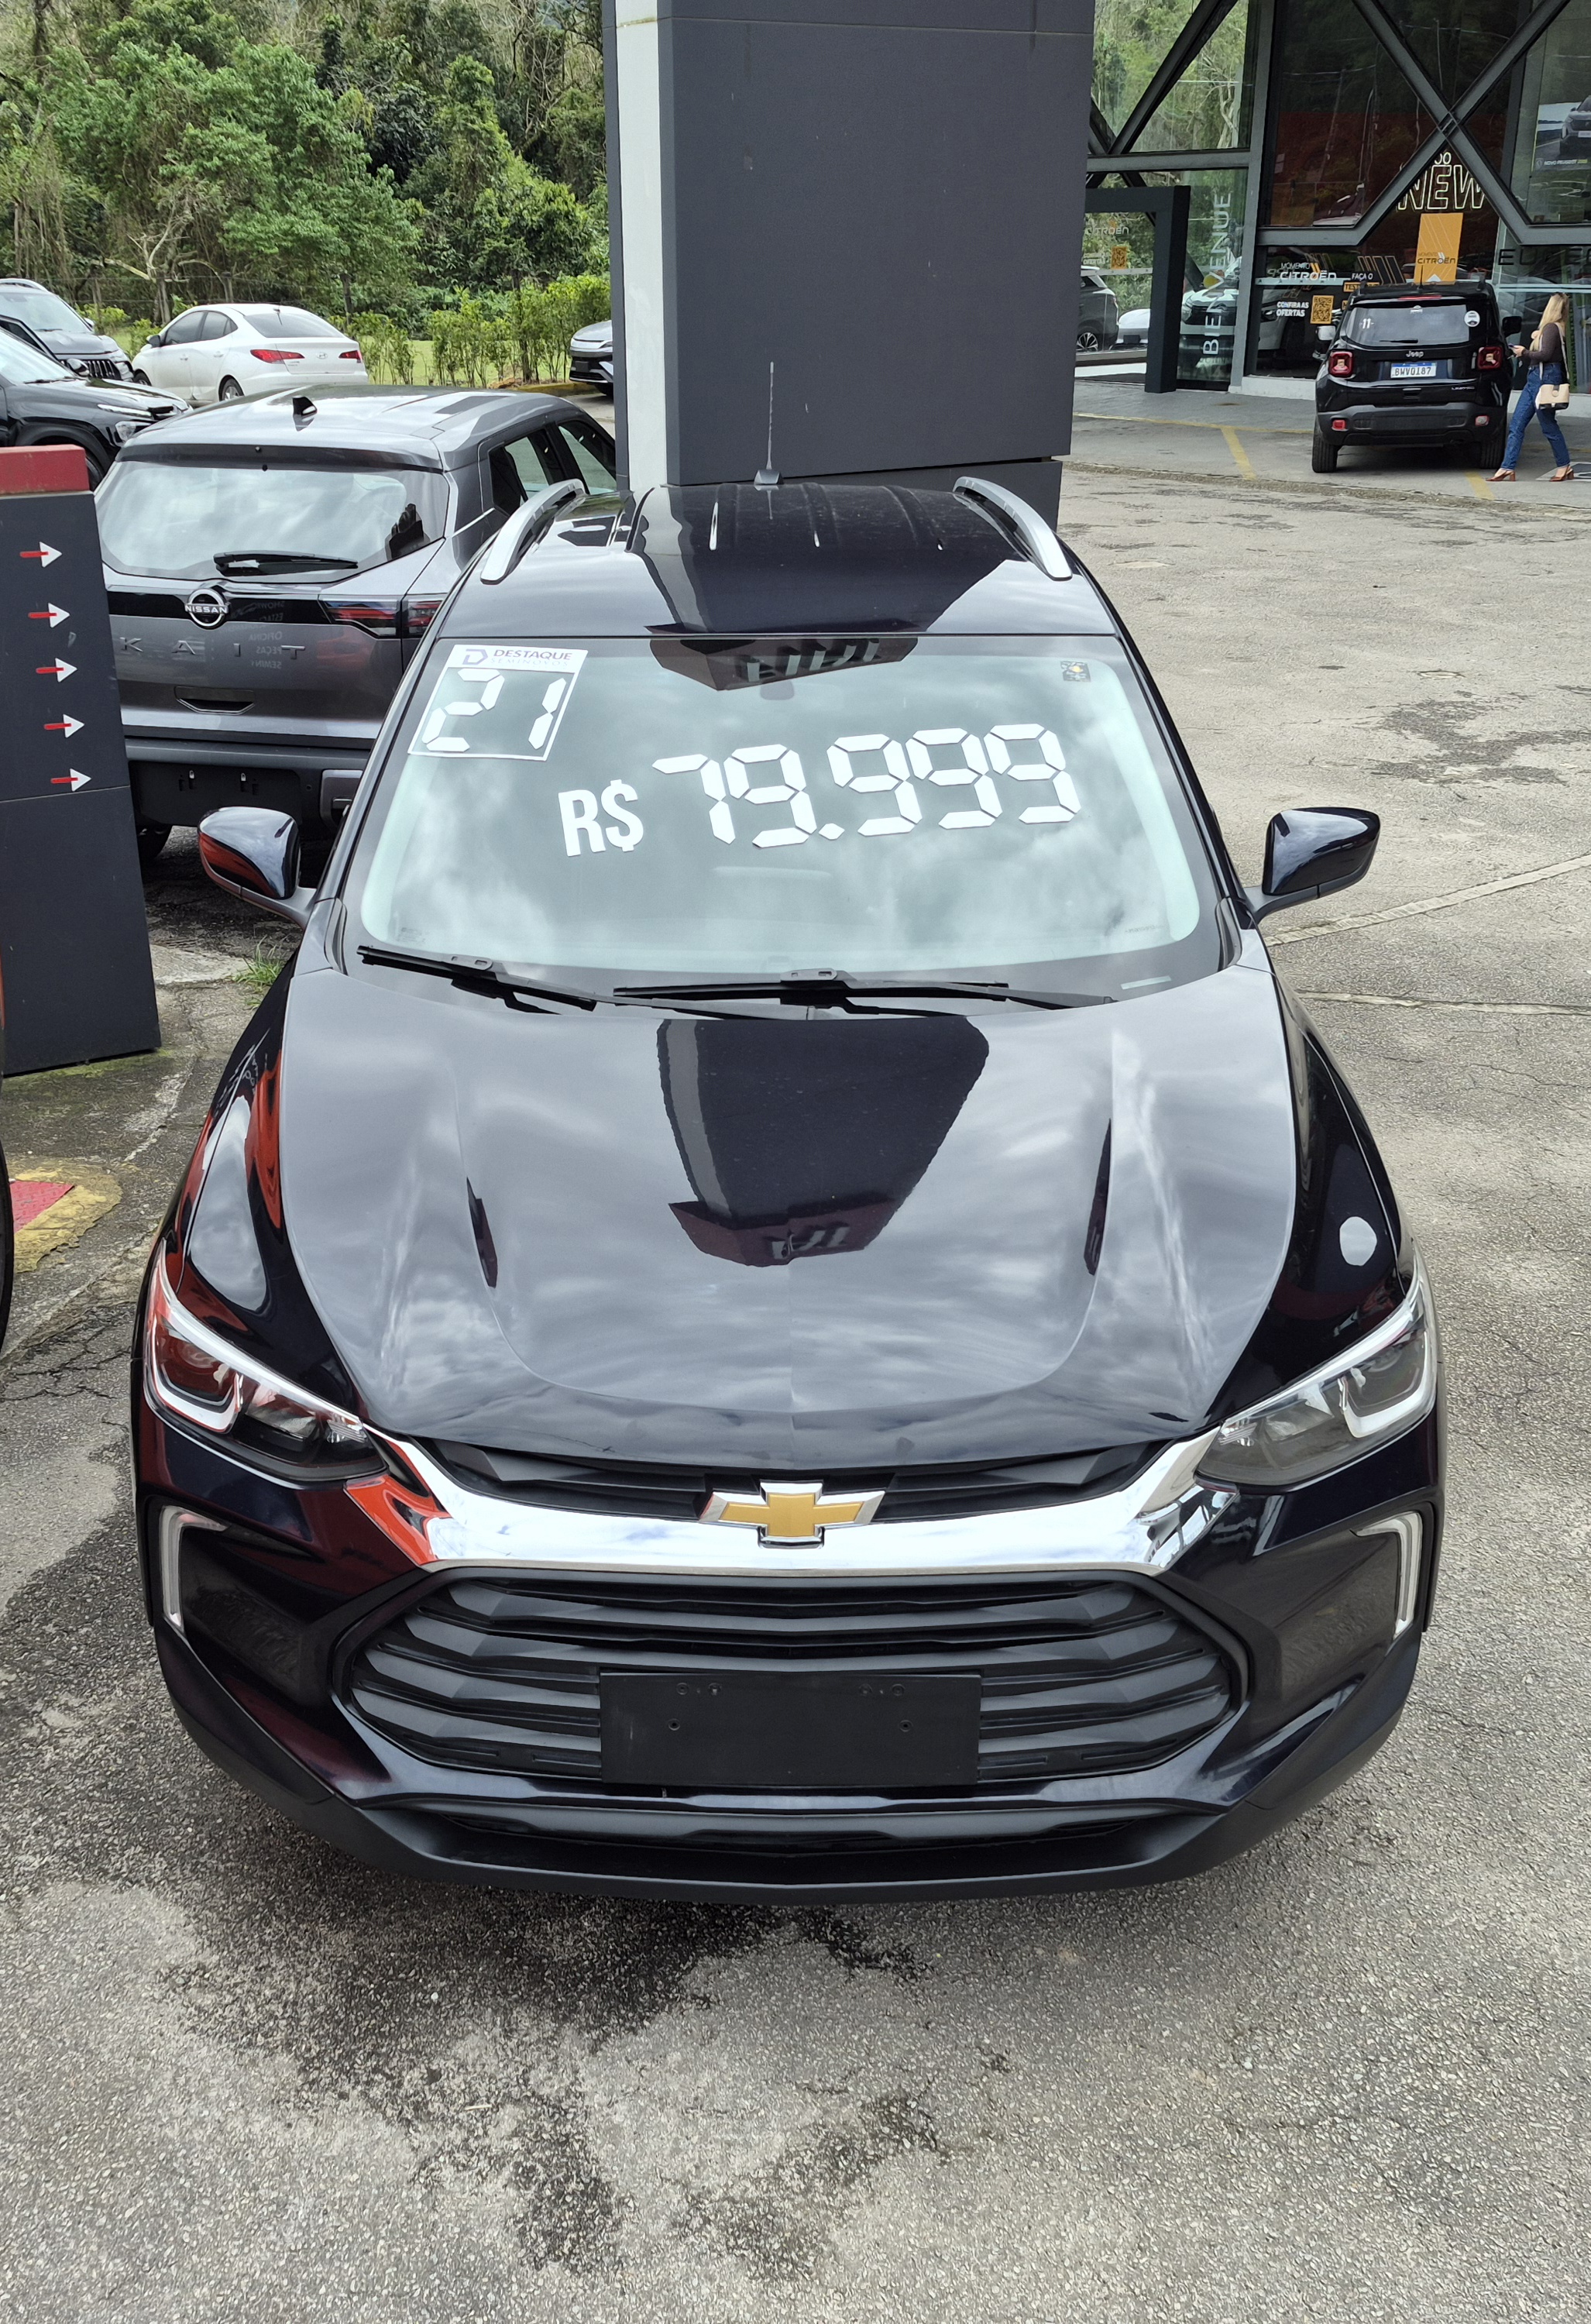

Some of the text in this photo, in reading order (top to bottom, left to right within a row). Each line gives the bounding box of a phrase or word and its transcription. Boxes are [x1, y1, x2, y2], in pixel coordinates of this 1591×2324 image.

[1202, 192, 1232, 356] BIENVENUE
[185, 604, 229, 614] NISSAN
[490, 658, 569, 667] SEMINOVOS
[493, 649, 573, 661] DESTAQUE
[421, 667, 567, 753] 21
[558, 723, 1081, 857] R$ 79.999
